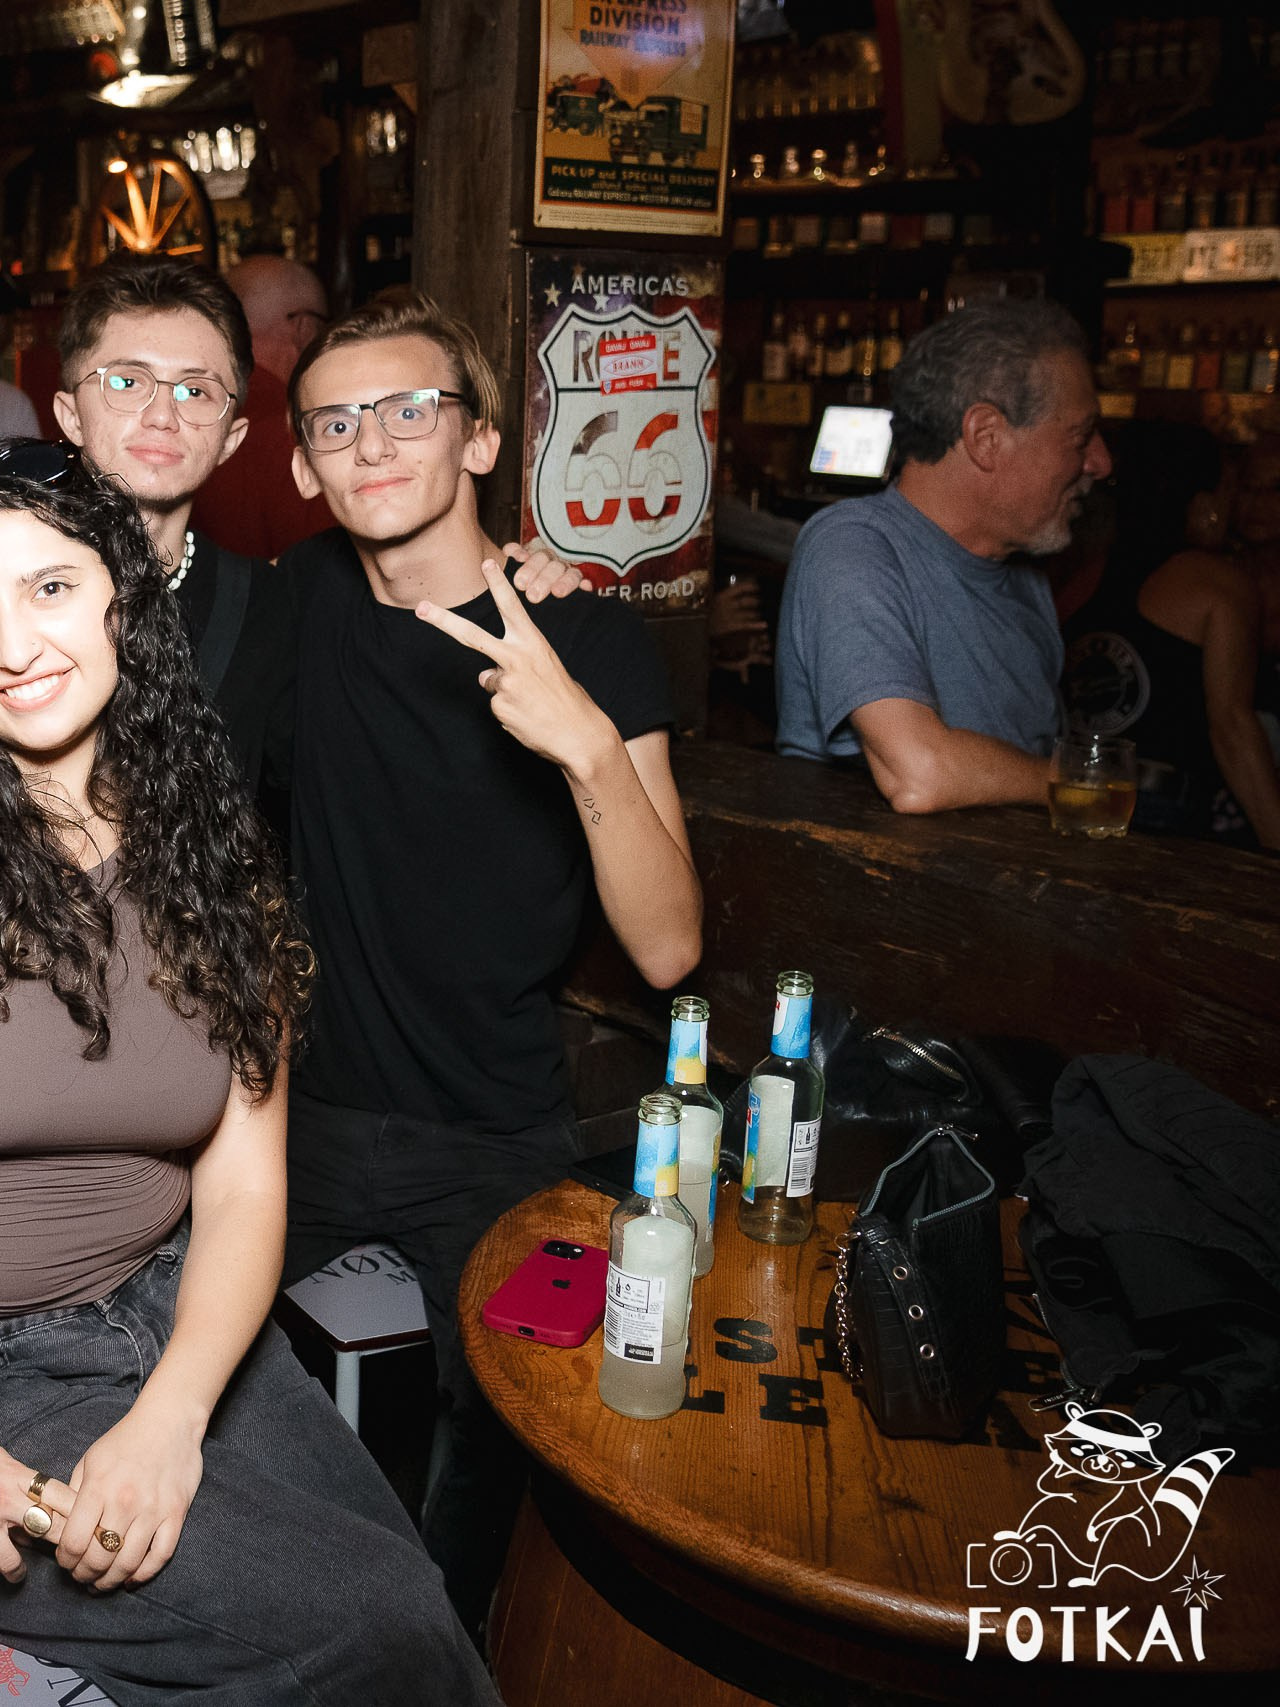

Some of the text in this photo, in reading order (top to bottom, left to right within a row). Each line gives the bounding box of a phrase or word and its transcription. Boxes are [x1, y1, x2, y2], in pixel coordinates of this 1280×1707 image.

[590, 7, 680, 35] DIVISION
[580, 29, 629, 48] RAILWAY
[551, 165, 576, 177] PICK
[579, 167, 595, 178] UP
[622, 169, 664, 184] SPECIAL
[669, 173, 715, 187] DELIVERY
[564, 410, 682, 539] 66
[640, 578, 695, 601] ROAD
